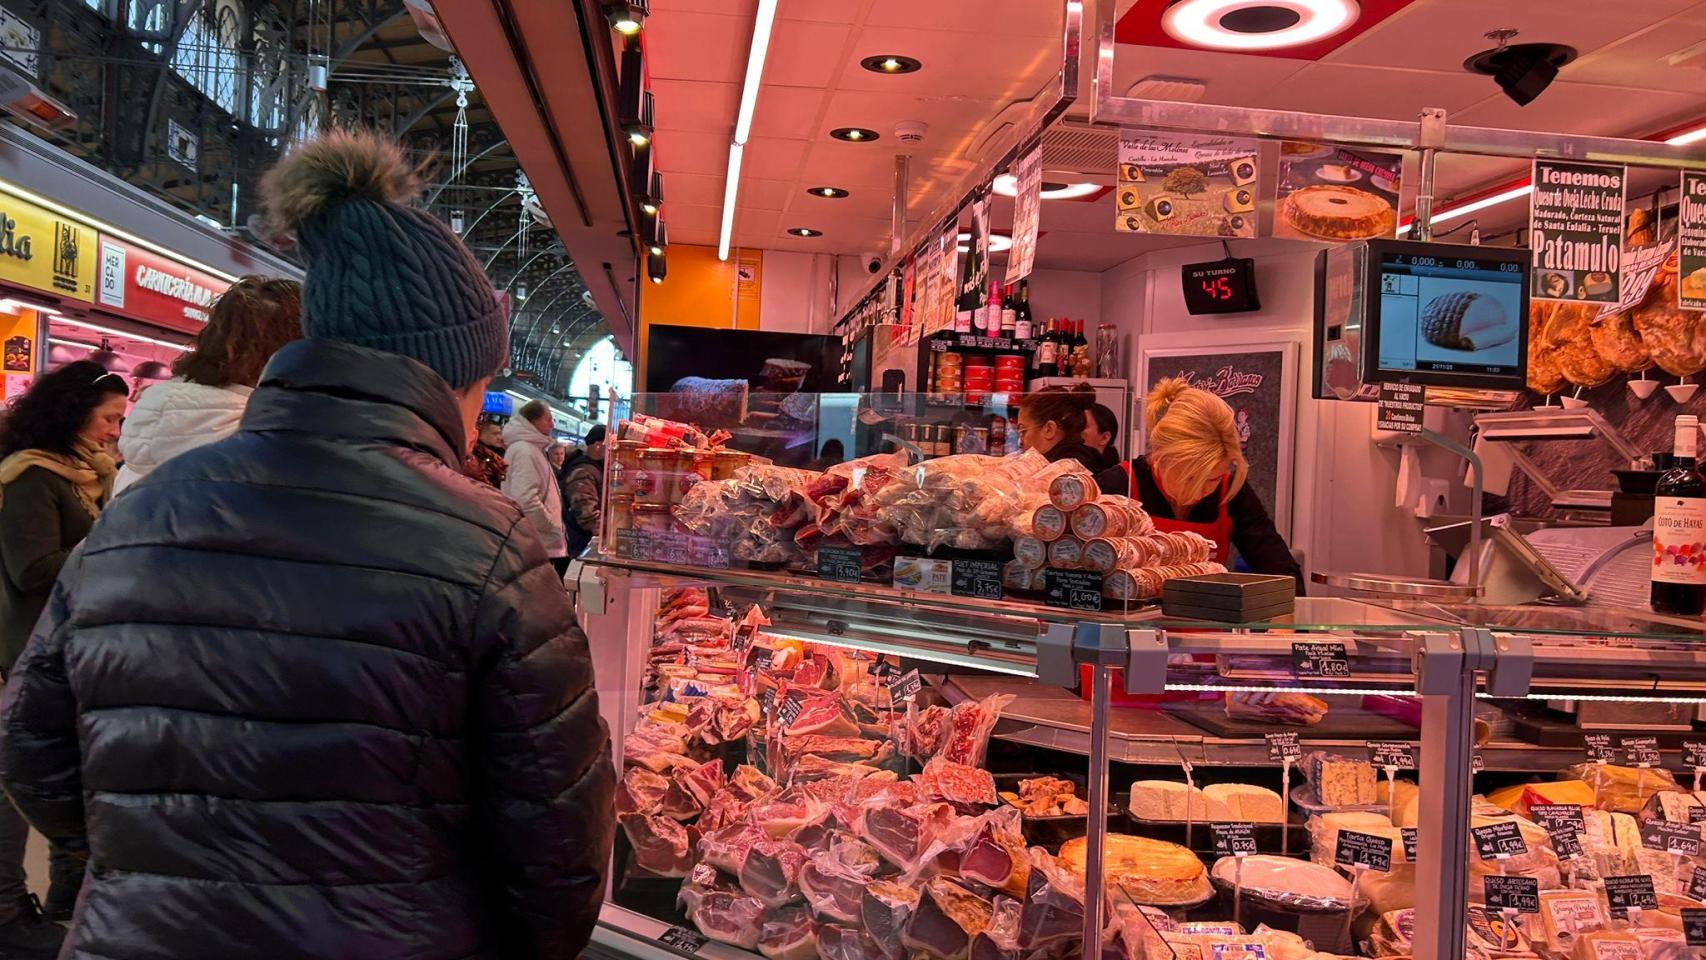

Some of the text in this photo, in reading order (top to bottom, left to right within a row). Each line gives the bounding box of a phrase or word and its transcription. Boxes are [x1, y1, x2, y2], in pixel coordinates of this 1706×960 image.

[1540, 166, 1621, 189] Tenemos
[1535, 186, 1621, 213] Queso de Oveja Leche Cruda
[1570, 210, 1595, 220] Corteza
[1597, 214, 1621, 223] Natural
[1533, 219, 1542, 229] de
[1544, 220, 1564, 230] Santa
[1598, 224, 1620, 234] Teruel
[1533, 230, 1618, 274] Patamulo
[106, 254, 119, 268] MER
[1411, 256, 1518, 273] 0,000 0,00 0,00
[105, 266, 114, 277] CA
[1206, 268, 1236, 276] TURNO
[105, 277, 114, 290] DO
[1202, 277, 1232, 299] 45
[1658, 517, 1703, 528] COTO DE HAYAS
[1475, 823, 1515, 836] Queso Morbier
[1645, 818, 1665, 827] Queso
[1665, 821, 1681, 829] Azul
[1346, 832, 1385, 845] Tarta Queso
[1671, 838, 1697, 851] 1,69€
[1502, 840, 1523, 852] 1,99€
[1361, 852, 1387, 866] 1,79€
[1507, 878, 1536, 886] ARTESANO
[1512, 895, 1535, 907] 1,99€
